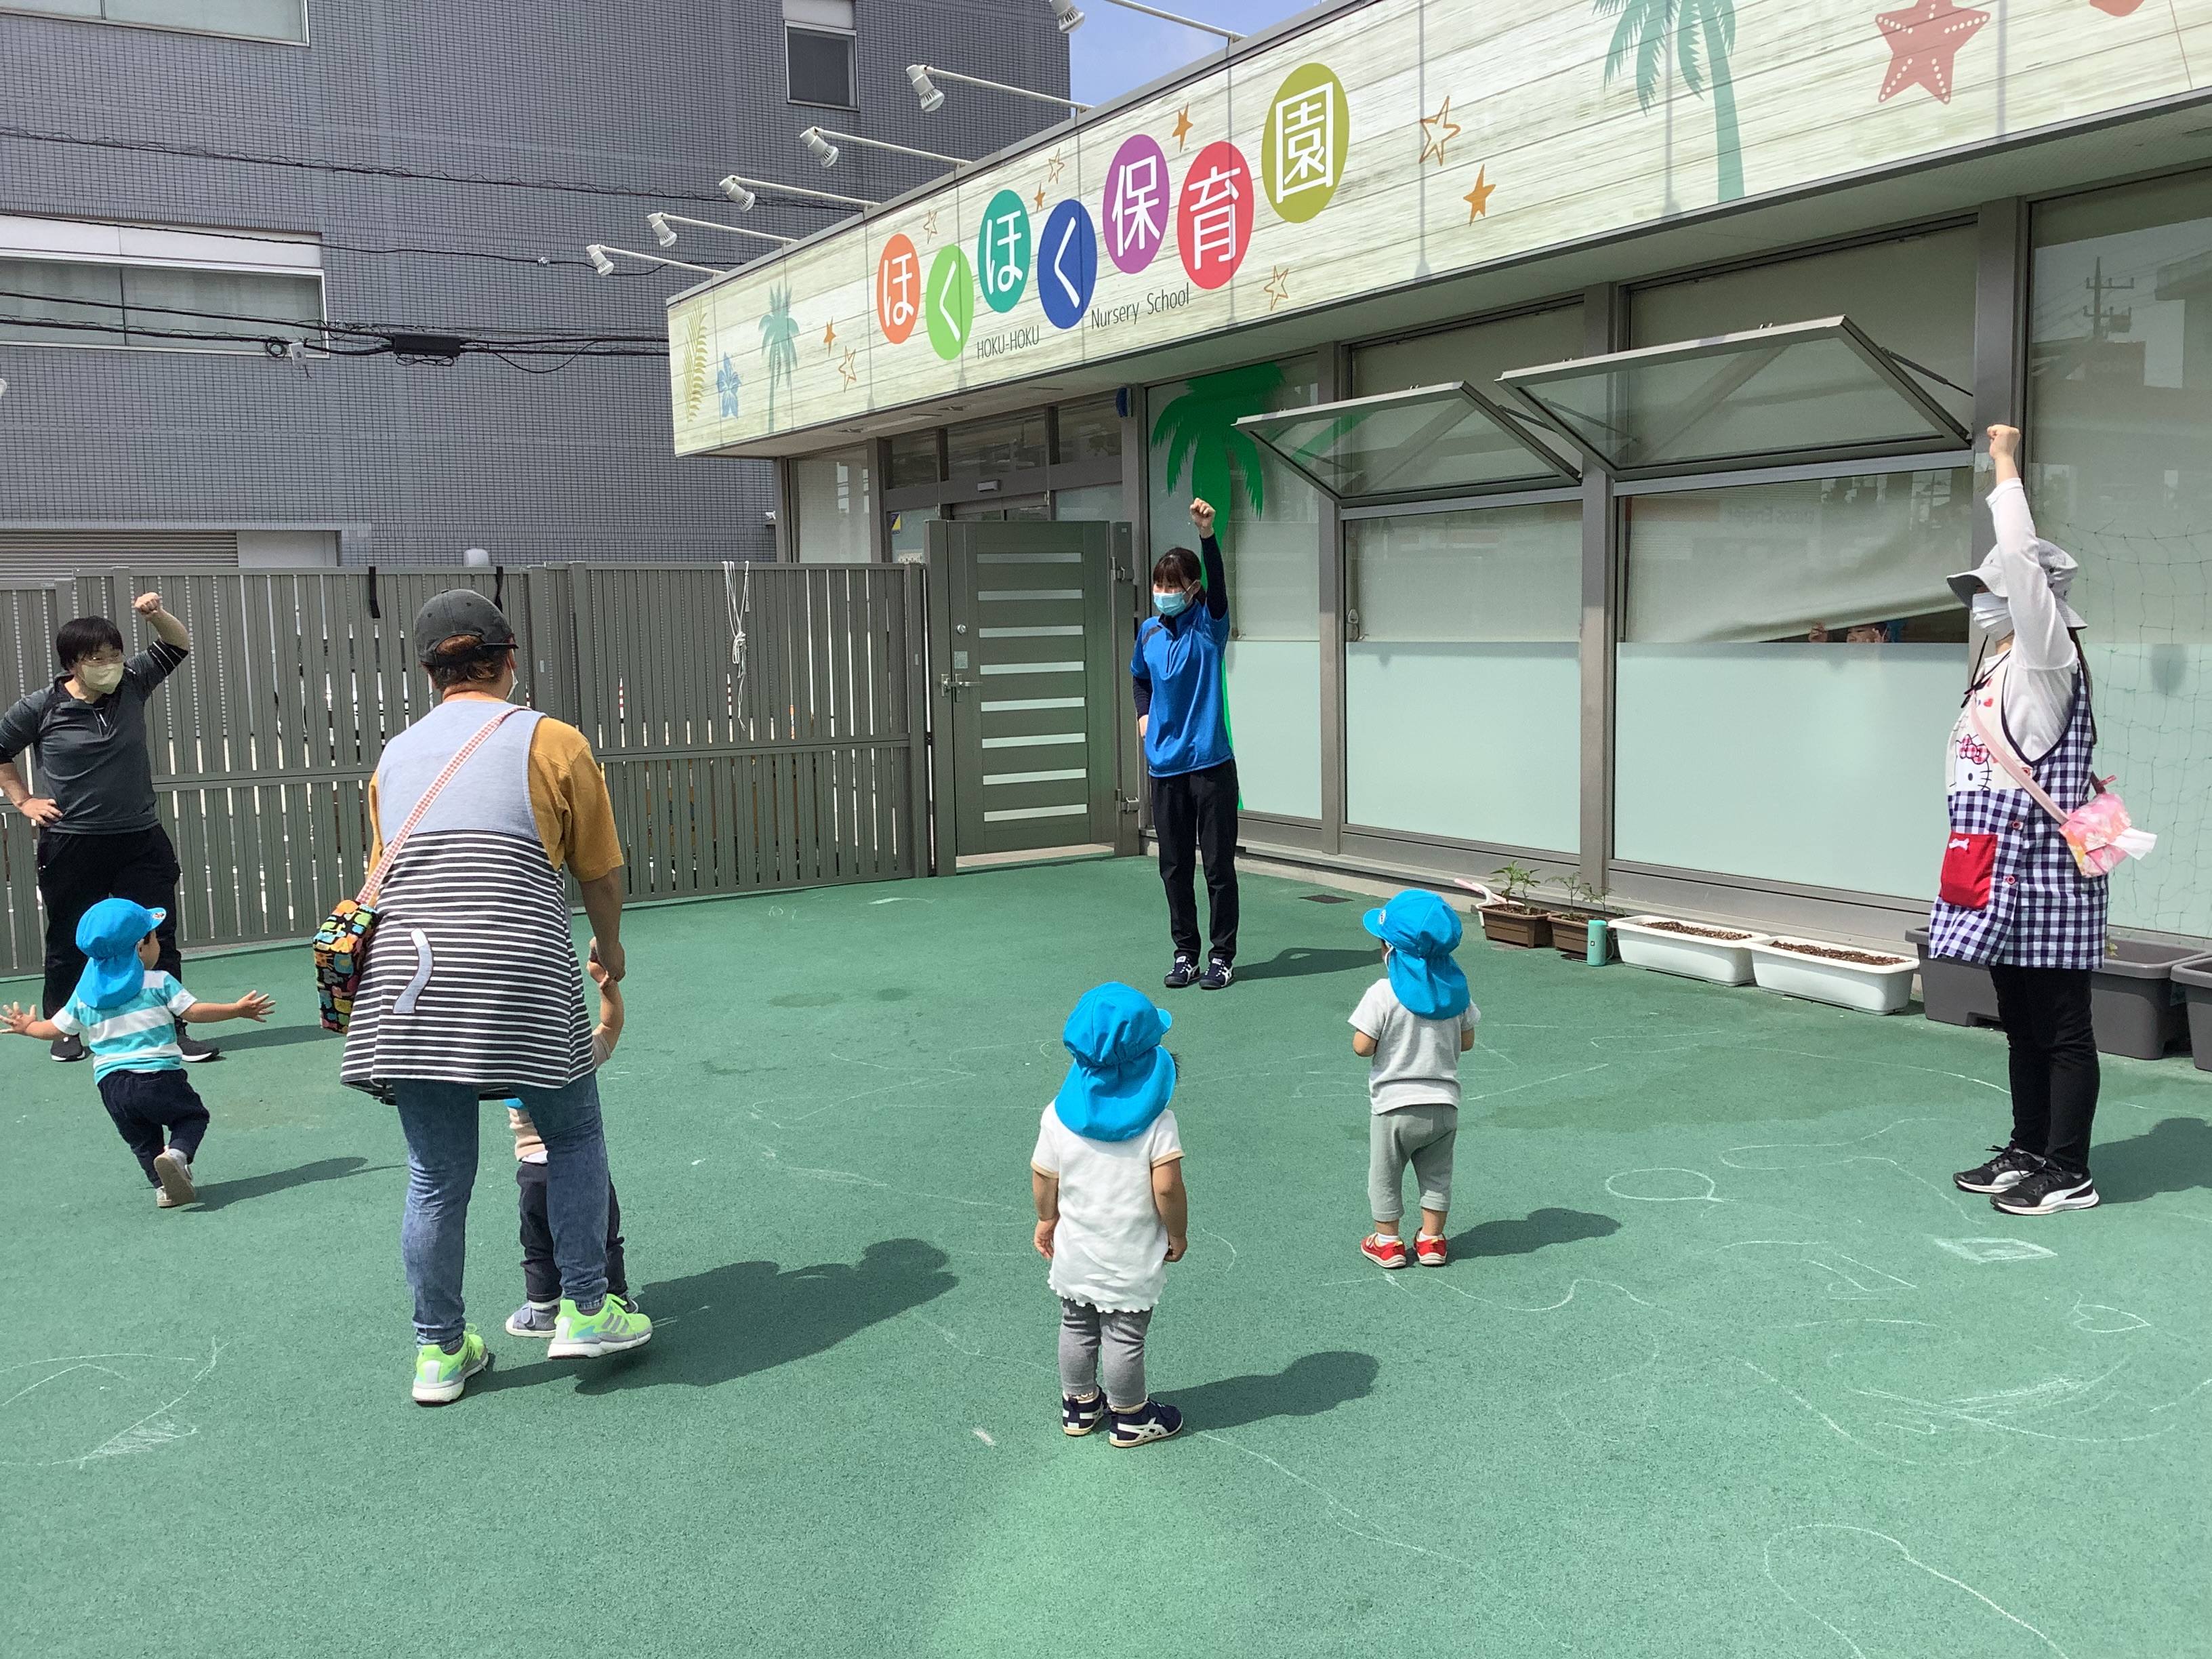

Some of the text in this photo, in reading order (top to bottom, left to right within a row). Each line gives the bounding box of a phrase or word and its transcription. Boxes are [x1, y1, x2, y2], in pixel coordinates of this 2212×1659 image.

[883, 81, 1334, 343] ほくほく保育園
[977, 282, 1189, 359] HOKU-HOKU Nursery School
